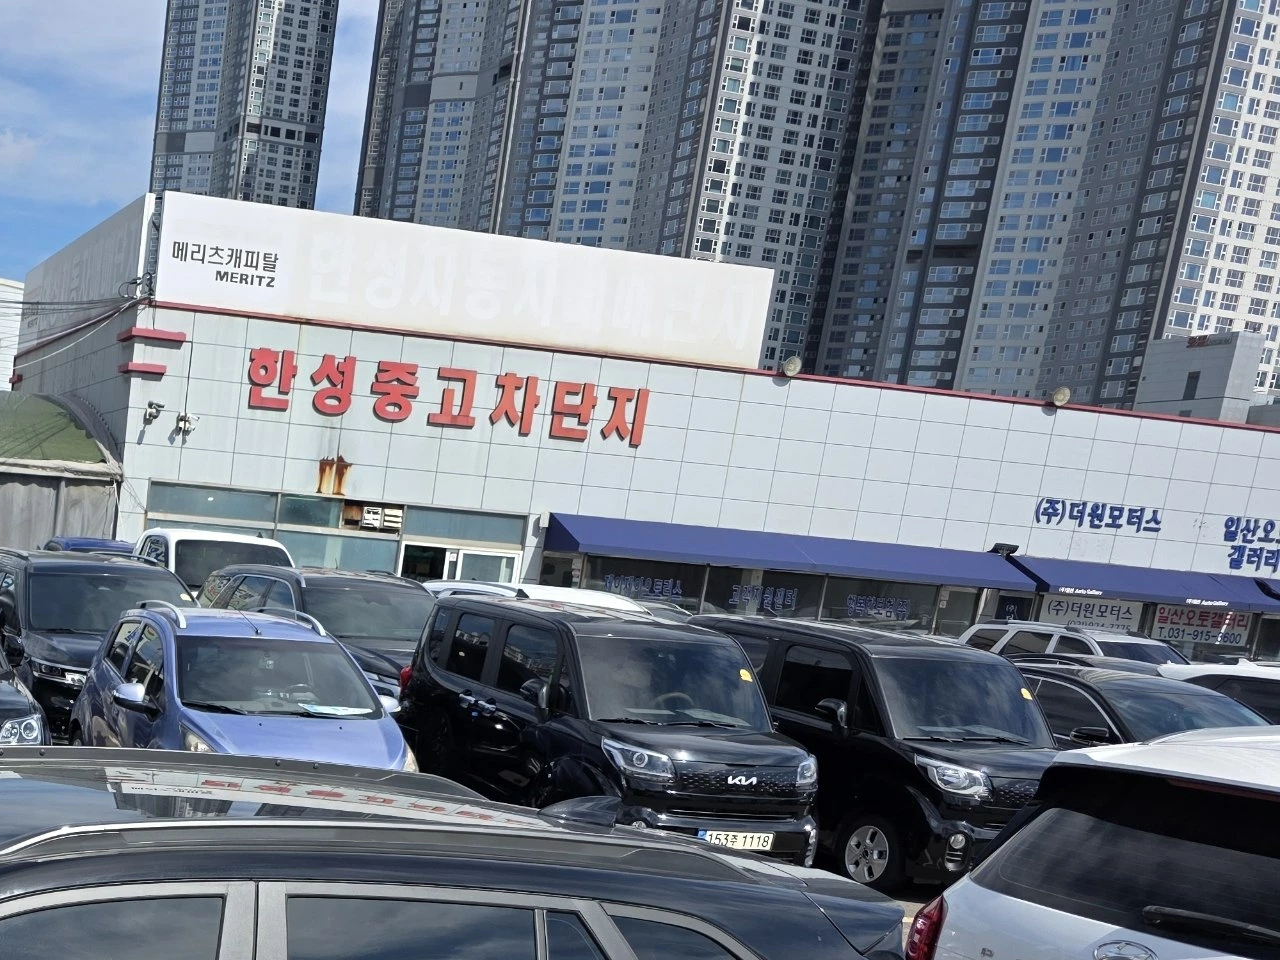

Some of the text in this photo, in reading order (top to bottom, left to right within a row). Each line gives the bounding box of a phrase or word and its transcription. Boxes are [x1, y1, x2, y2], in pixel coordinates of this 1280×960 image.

[171, 240, 279, 273] 메리츠캐피탈
[215, 270, 276, 288] MERITZ
[247, 346, 651, 448] 한성중고차단지
[1035, 497, 1163, 534] (주)더원모터스
[1223, 516, 1280, 544] 일산오
[1227, 544, 1280, 574] 갤러리
[1047, 599, 1134, 621] (주)더원모터스
[1157, 606, 1251, 632] 일산오토갤러리
[742, 834, 770, 848] 1118
